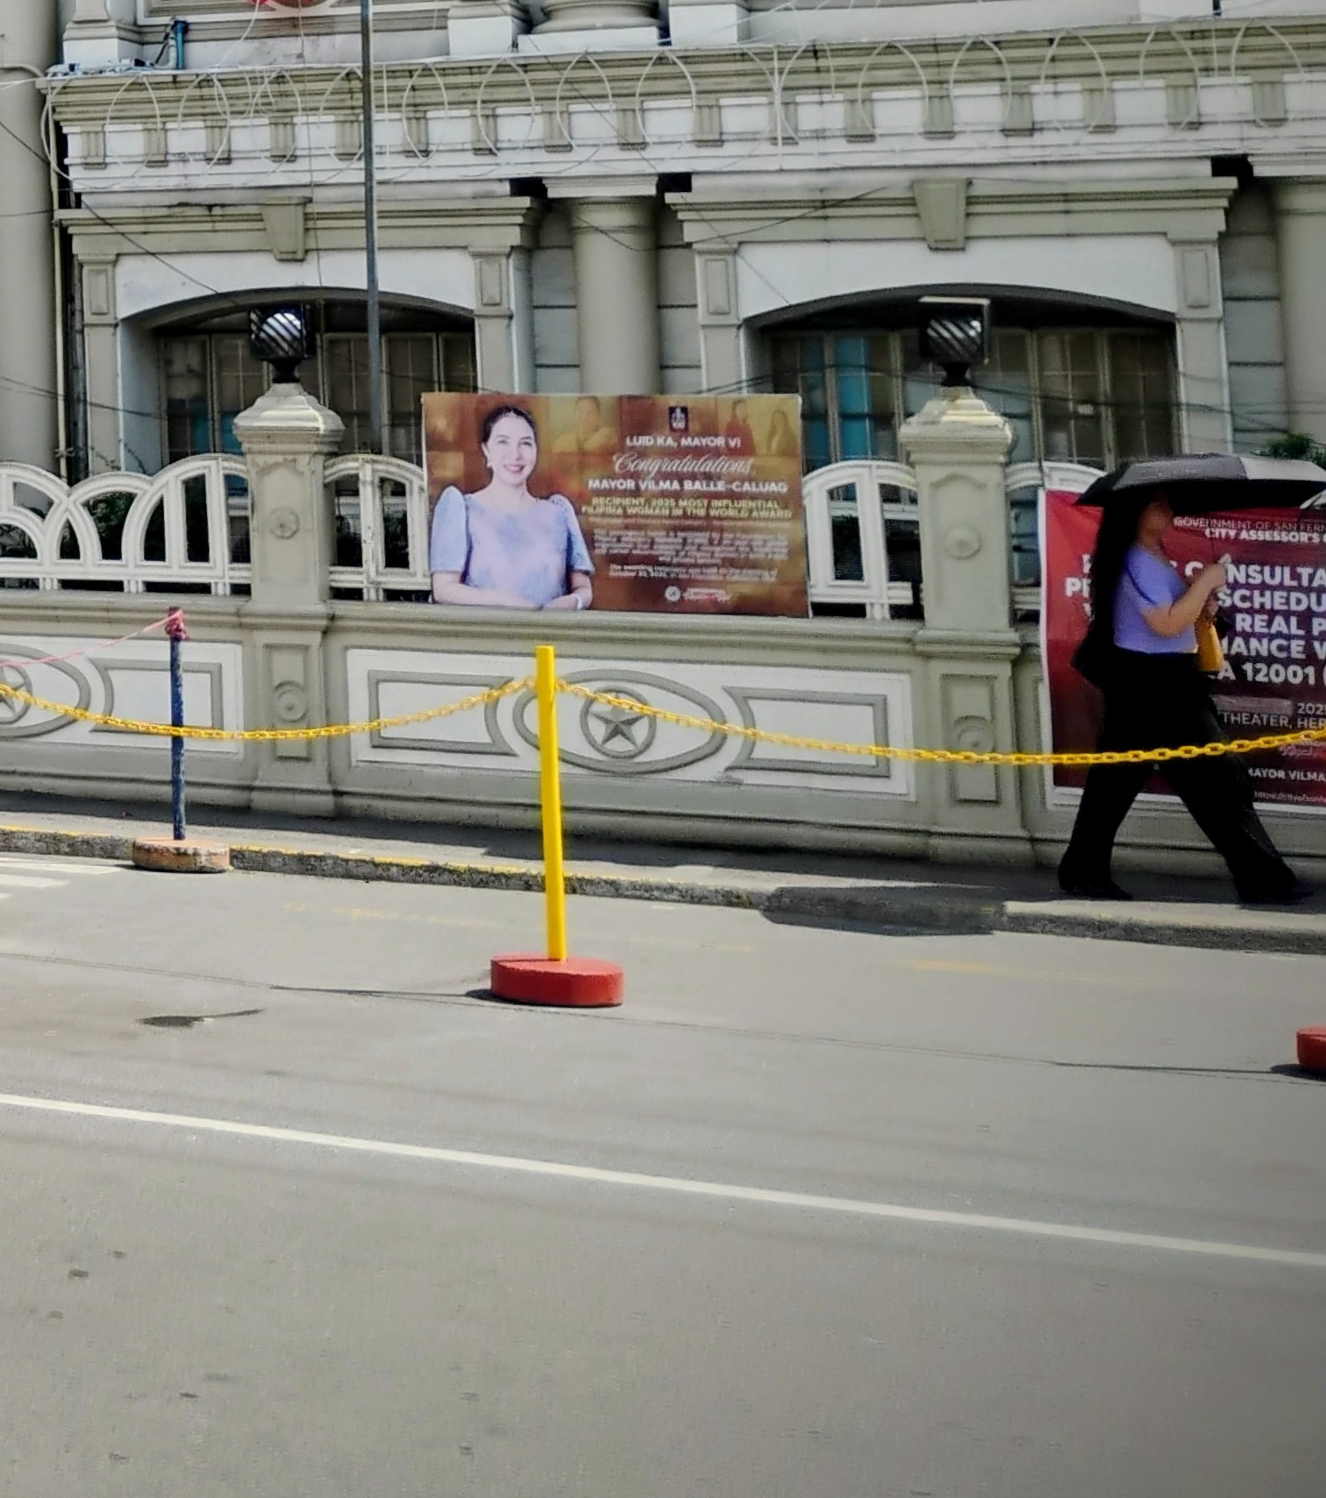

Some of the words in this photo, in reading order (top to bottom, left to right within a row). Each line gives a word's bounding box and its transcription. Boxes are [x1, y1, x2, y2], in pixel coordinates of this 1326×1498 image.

[680, 436, 725, 447] MAYOR
[588, 478, 635, 491] MAYOR
[638, 479, 680, 491] VILMA
[678, 498, 708, 507] MOST
[626, 506, 670, 515] WOMAN
[710, 508, 747, 518] WORLD
[751, 509, 793, 518] AWARD
[1255, 521, 1271, 531] OF
[1273, 521, 1297, 531] SAN
[1205, 527, 1237, 539] CITY
[1239, 529, 1319, 543] ASSESSOR'S
[1235, 613, 1306, 635] REAL
[1241, 662, 1316, 685] 12001
[1288, 770, 1326, 782] VILMA
